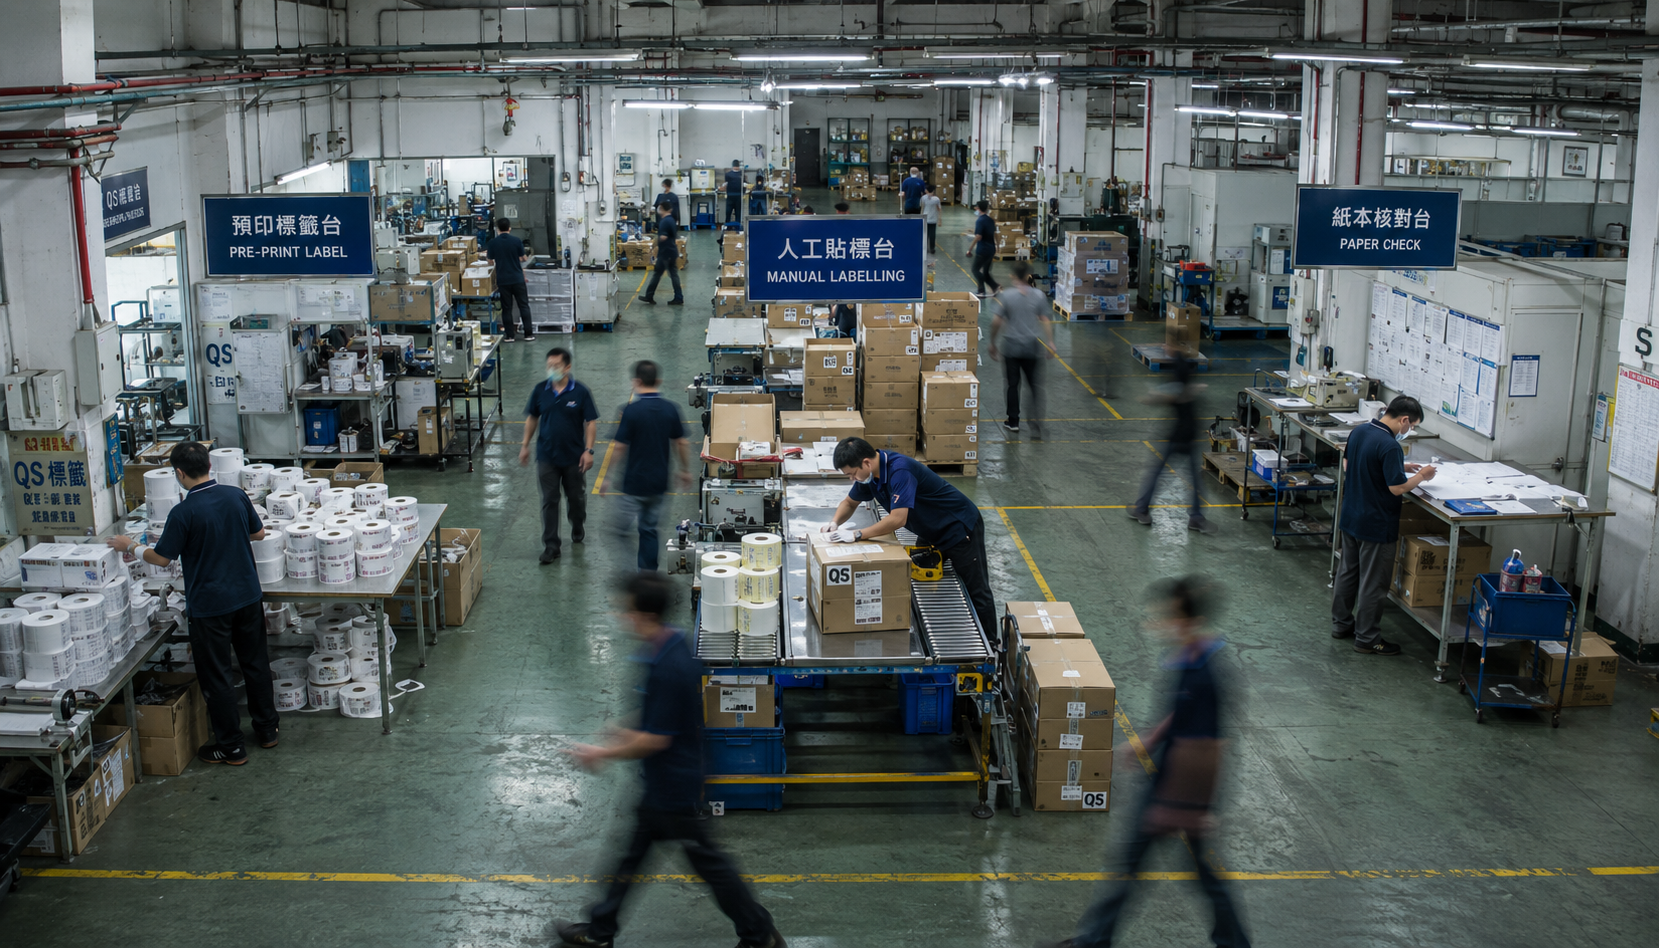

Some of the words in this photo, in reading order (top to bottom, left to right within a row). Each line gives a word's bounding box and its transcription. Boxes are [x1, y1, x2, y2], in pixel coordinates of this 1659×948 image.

[231, 214, 341, 236] 預印標籤台
[1331, 206, 1431, 229] 紙本核對台
[229, 246, 301, 258] PRE-PRINT
[305, 246, 348, 258] LABEL
[777, 237, 895, 260] 人工貼標台
[1340, 238, 1379, 250] PAPER
[1383, 238, 1421, 251] CHECK
[767, 270, 826, 283] MANUAL
[830, 269, 906, 282] LABELLING
[205, 343, 233, 367] QS
[828, 567, 850, 584] QS
[1084, 793, 1105, 808] QS
